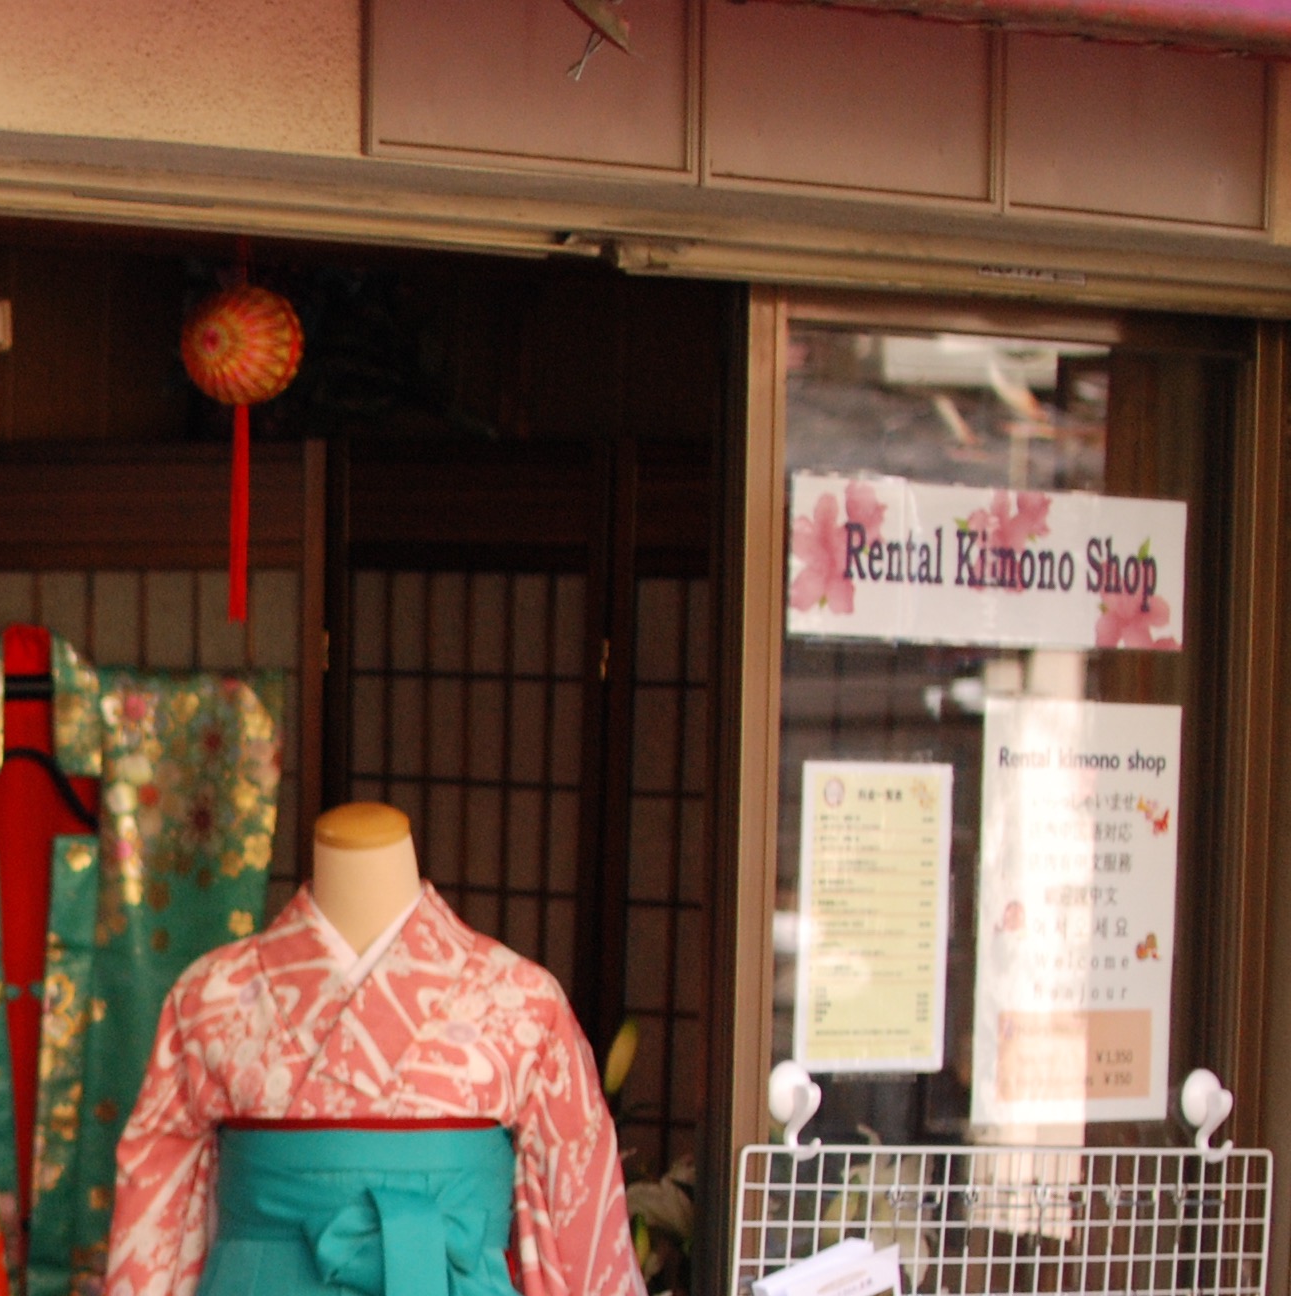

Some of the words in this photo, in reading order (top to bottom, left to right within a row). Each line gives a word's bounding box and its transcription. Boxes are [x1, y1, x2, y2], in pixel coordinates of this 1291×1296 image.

[843, 521, 944, 585] Rental
[953, 526, 1076, 594] Kimono
[1085, 536, 1159, 613] Shop
[998, 745, 1051, 769] Rental
[1058, 748, 1121, 771] kimono
[1126, 749, 1167, 777] shop
